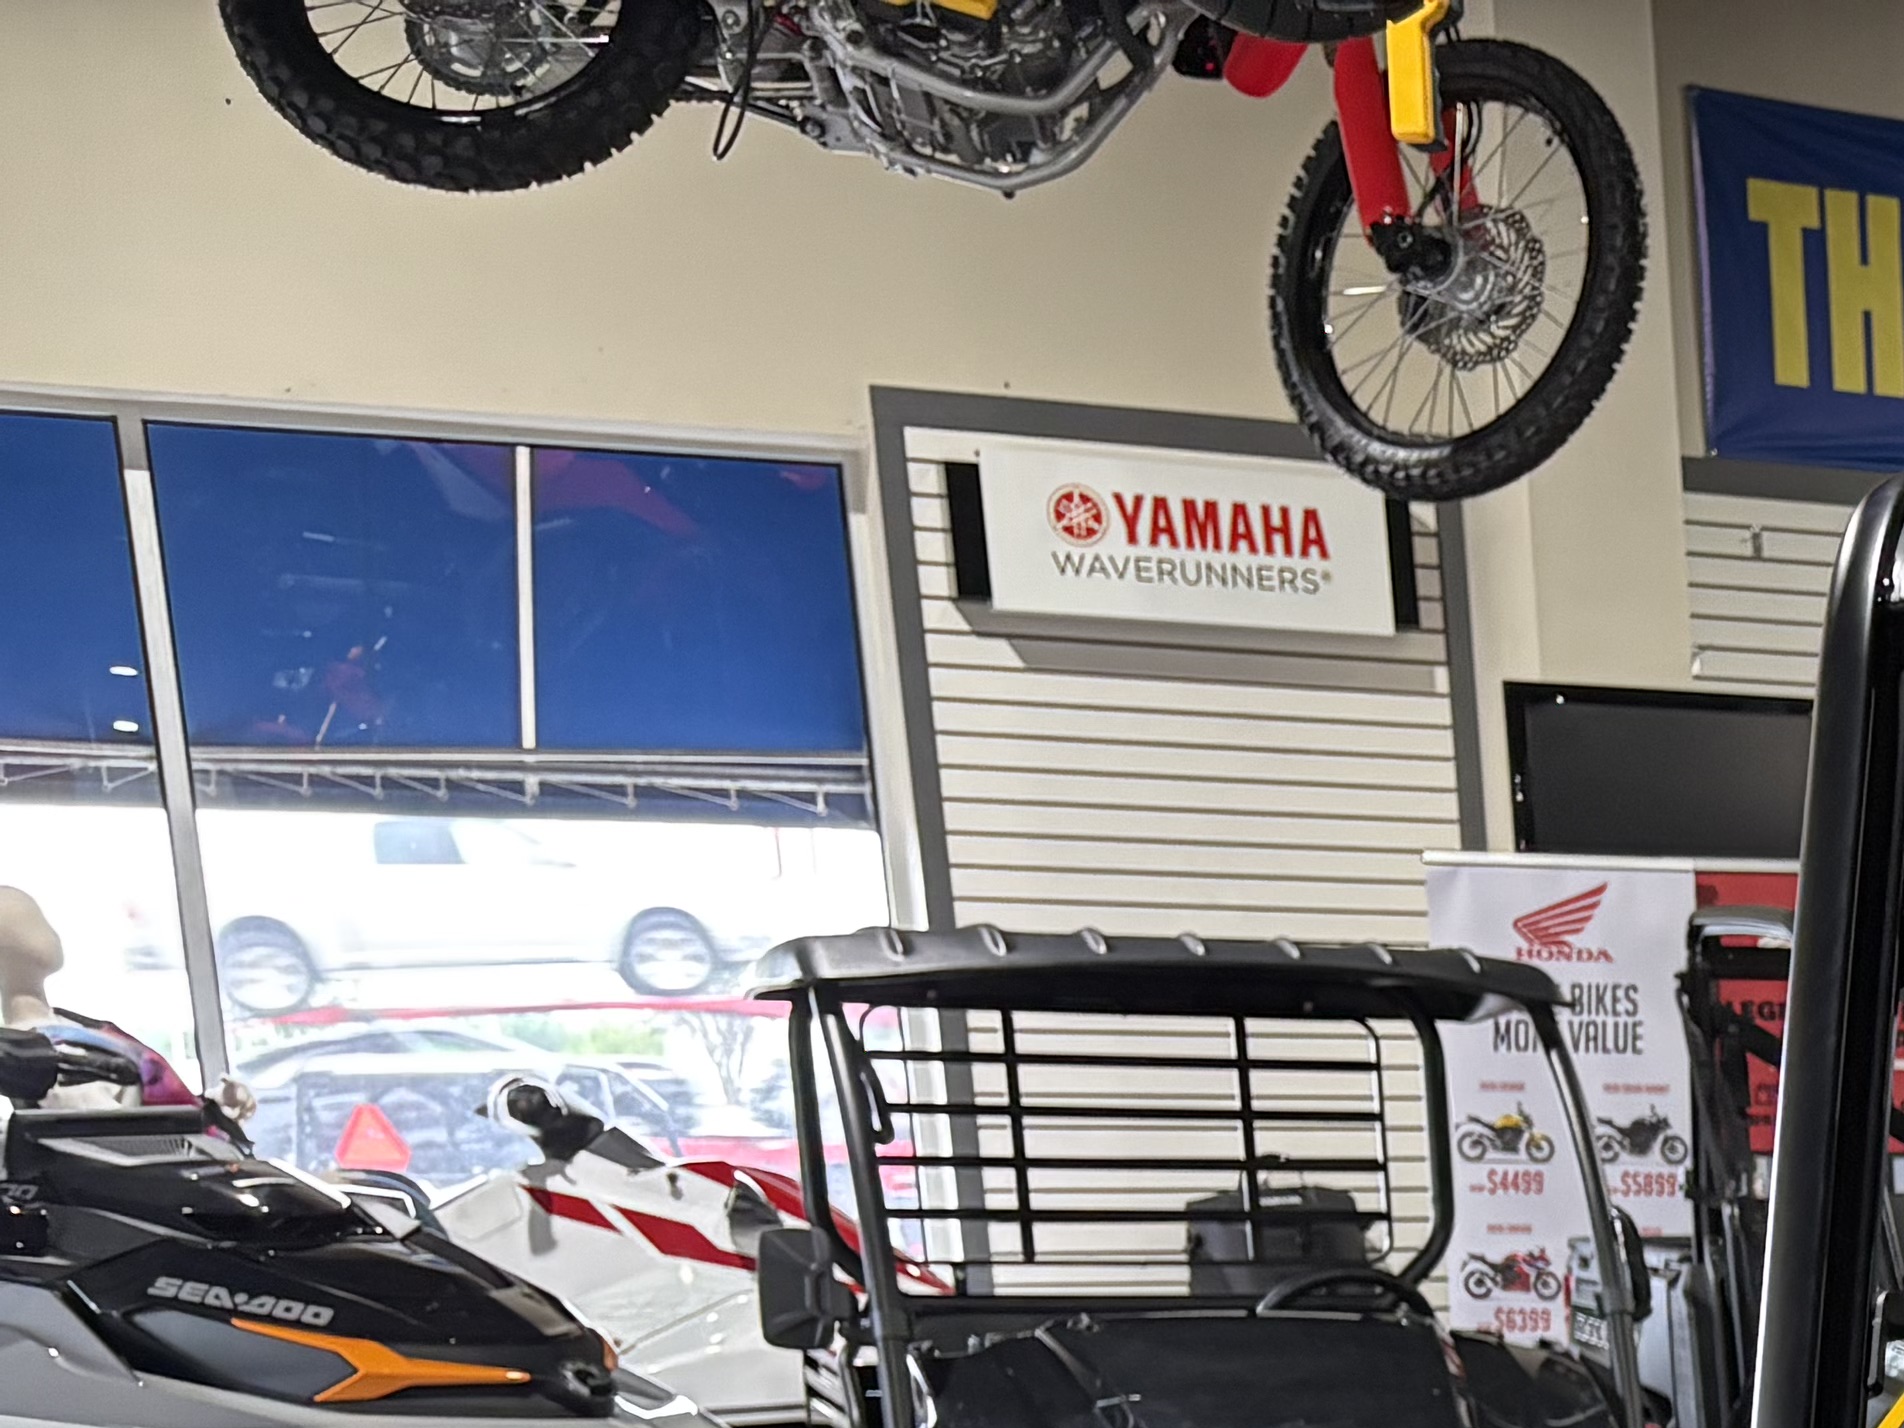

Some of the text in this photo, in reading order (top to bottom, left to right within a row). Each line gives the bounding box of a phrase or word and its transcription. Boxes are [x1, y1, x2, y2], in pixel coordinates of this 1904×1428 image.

[1112, 491, 1331, 561] YAMAHA
[1514, 945, 1614, 964] HONDA
[1570, 982, 1640, 1019] BIKES
[1568, 1019, 1644, 1056] VALUE
